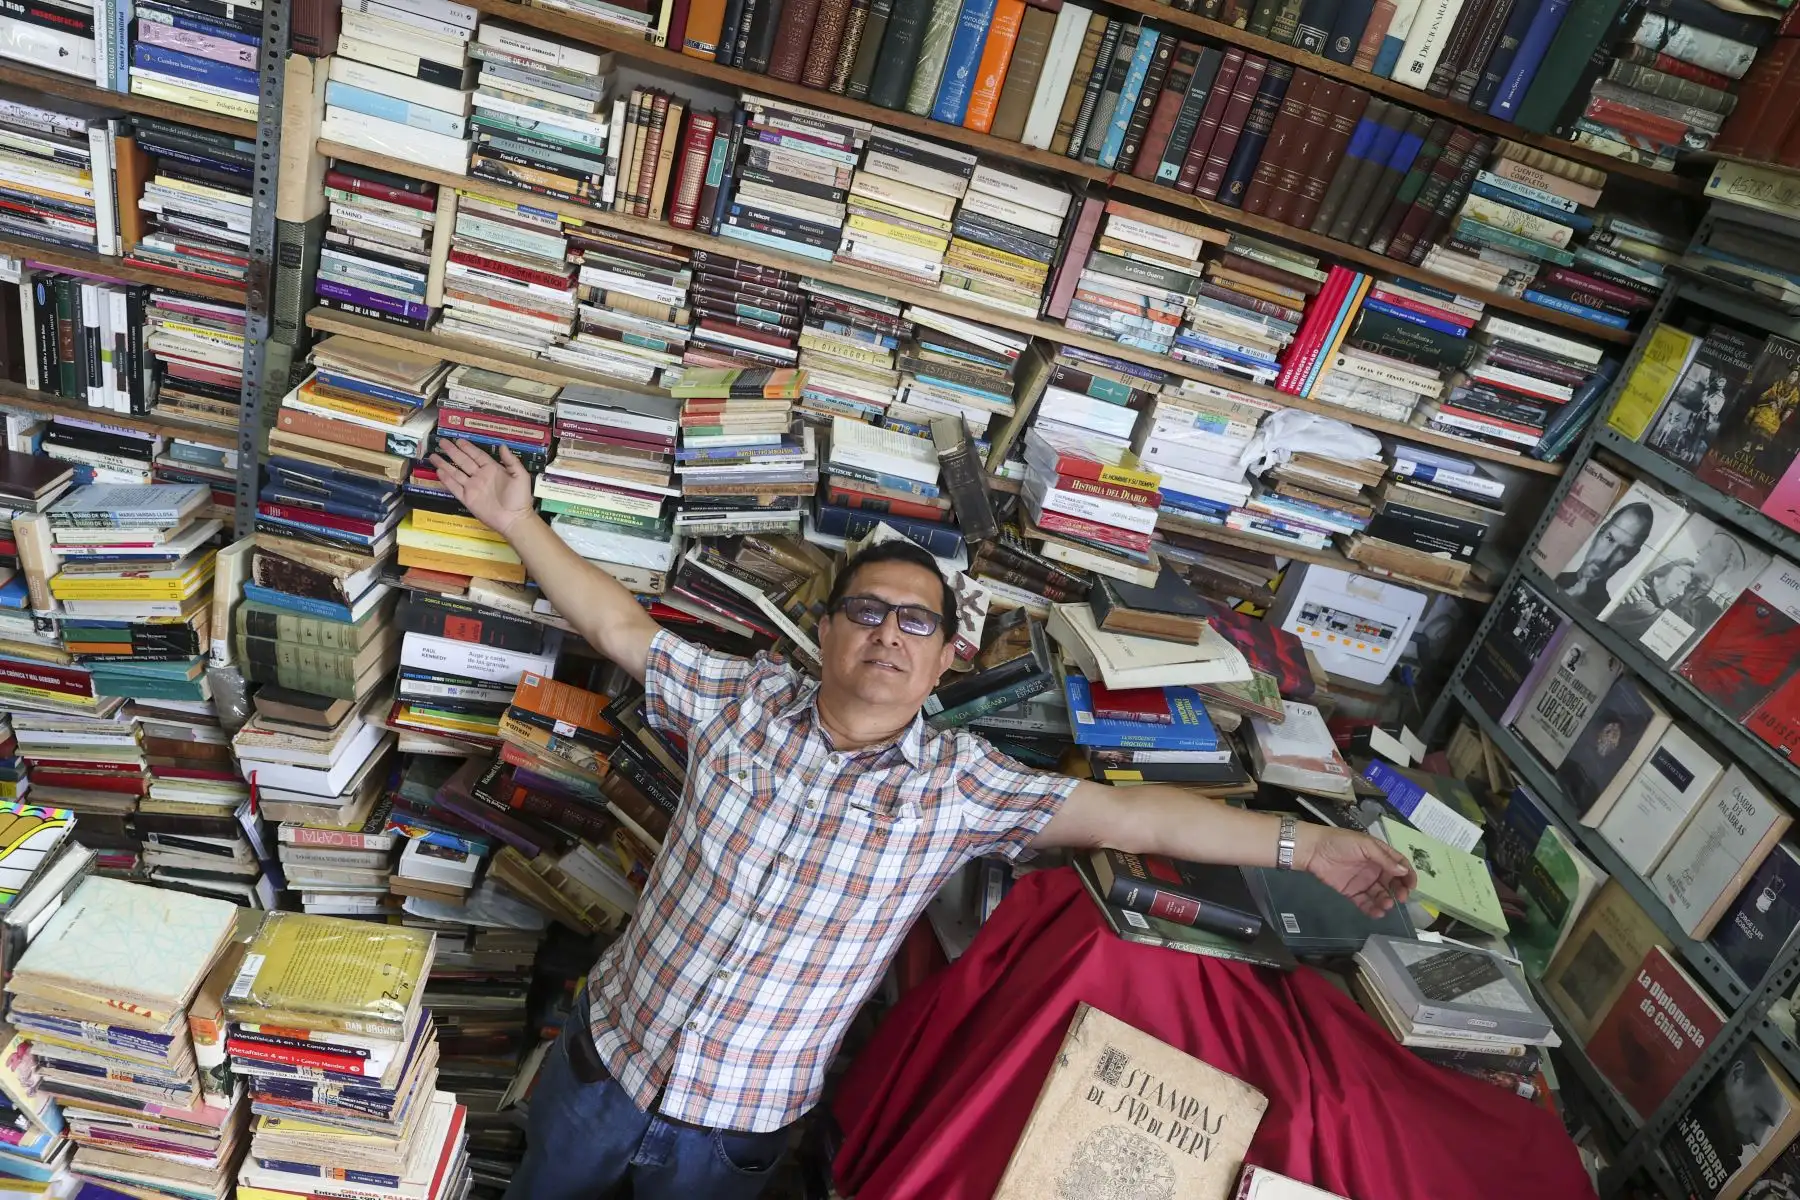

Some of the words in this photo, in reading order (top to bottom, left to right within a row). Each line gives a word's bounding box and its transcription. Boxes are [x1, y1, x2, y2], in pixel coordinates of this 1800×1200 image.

[486, 50, 509, 61] NOMBRE
[521, 58, 529, 66] LA
[1514, 165, 1543, 180] CUENTOS
[1510, 172, 1549, 190] COMPLETOS
[336, 209, 362, 220] CAMINO
[700, 216, 710, 225] 35
[1135, 267, 1144, 275] Gran
[657, 295, 672, 303] Freud
[1571, 292, 1602, 309] GANDHI
[341, 303, 353, 312] LIBRO
[369, 310, 380, 318] VIDA
[1765, 342, 1794, 360] JUNG
[1281, 369, 1294, 386] HEGEL
[1289, 357, 1307, 388] HEIDEGGER
[1297, 350, 1319, 390] KIERKEGAARD
[563, 422, 578, 430] ROTH
[561, 431, 575, 439] ROTH
[1109, 474, 1126, 484] HOMBRE
[1138, 478, 1154, 488] TIEMPO
[1072, 479, 1105, 495] HISTORIA
[1107, 488, 1120, 496] DEL
[1121, 490, 1147, 503] DIABLO
[424, 597, 440, 606] JORGE
[478, 609, 499, 618] Cuentos
[422, 647, 436, 655] PAUL
[422, 652, 447, 662] KENNEDY
[469, 651, 483, 660] Auge
[1732, 787, 1757, 817] CAMBIO
[1718, 800, 1747, 837] PALABRAS
[347, 833, 359, 847] EL
[1637, 969, 1651, 988] La
[1650, 981, 1706, 1048] Diplomacia
[345, 1021, 363, 1031] DAN
[365, 1024, 396, 1036] BROWN
[1640, 998, 1654, 1014] de
[1650, 1011, 1684, 1050] China
[234, 1032, 274, 1044] Metafísica
[306, 1043, 324, 1051] Conny
[229, 1046, 268, 1058] Metafísica
[300, 1058, 318, 1067] Conny
[319, 1062, 346, 1070] Mendez
[1690, 1121, 1728, 1183] HOMBRE
